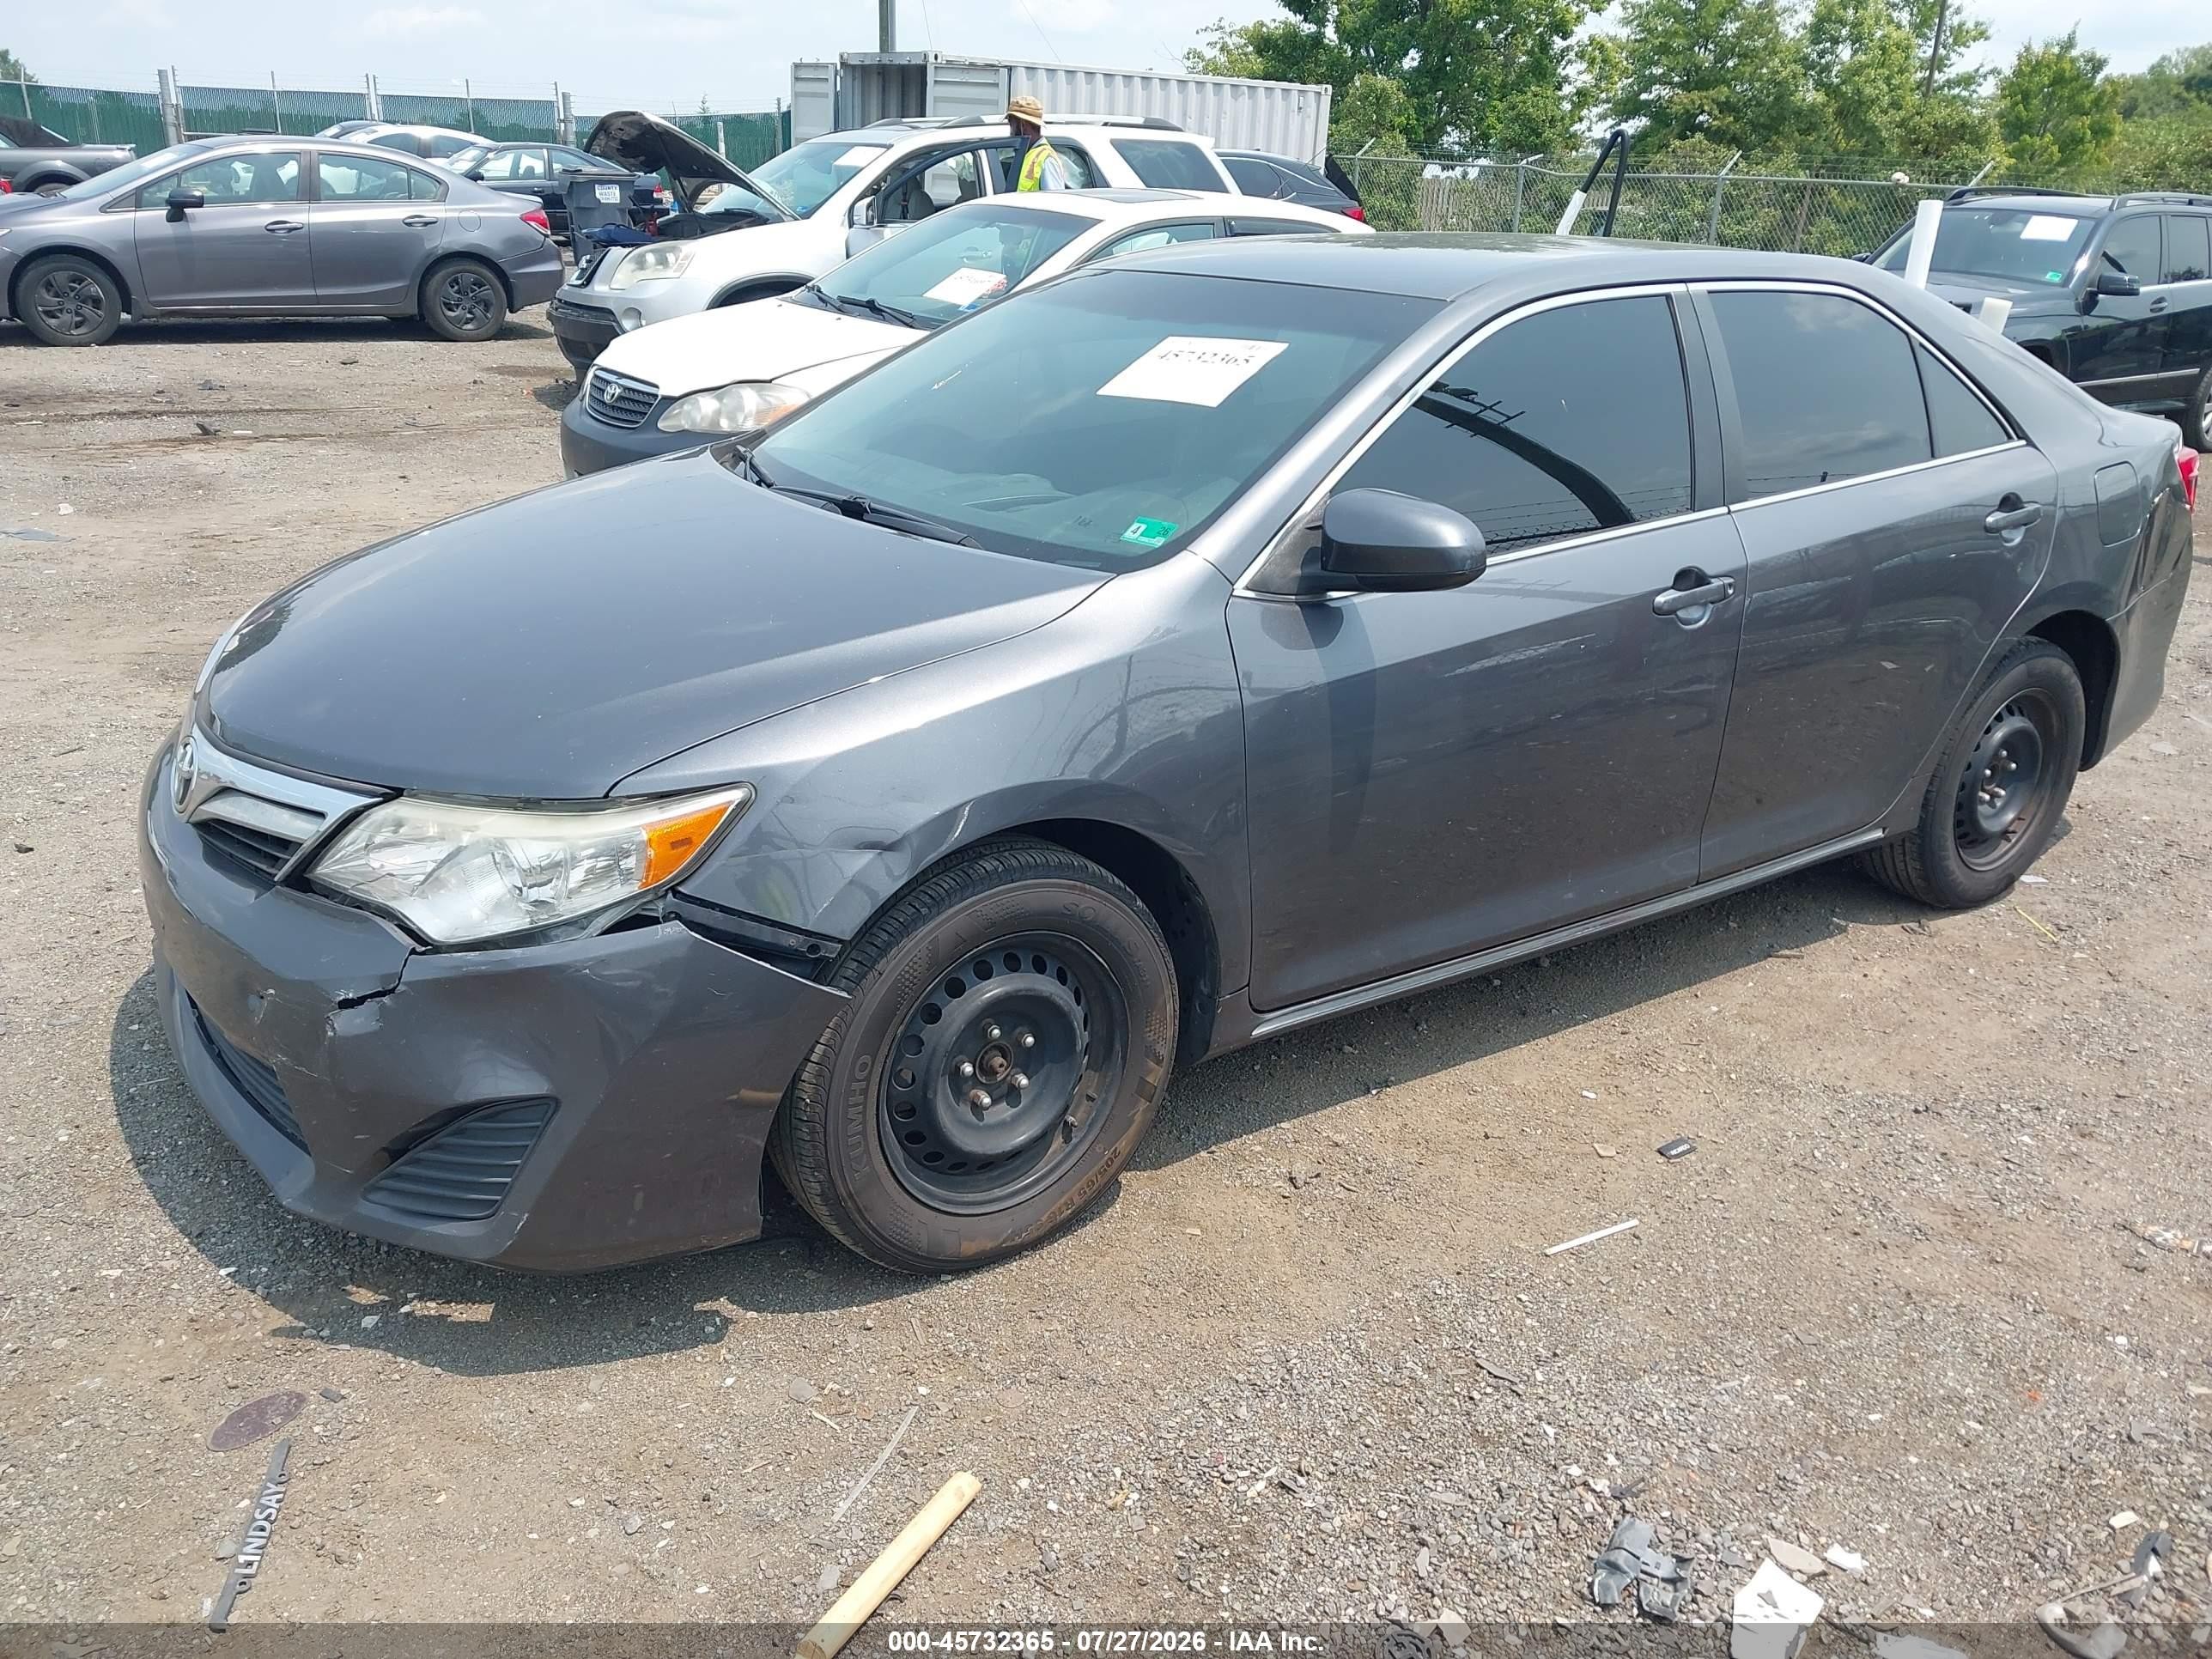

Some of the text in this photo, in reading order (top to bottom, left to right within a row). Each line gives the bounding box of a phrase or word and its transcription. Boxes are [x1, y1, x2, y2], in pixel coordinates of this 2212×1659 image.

[1131, 525, 1171, 537] 4 26
[846, 1054, 872, 1182] KUMHO
[1077, 1146, 1121, 1200] 205/65
